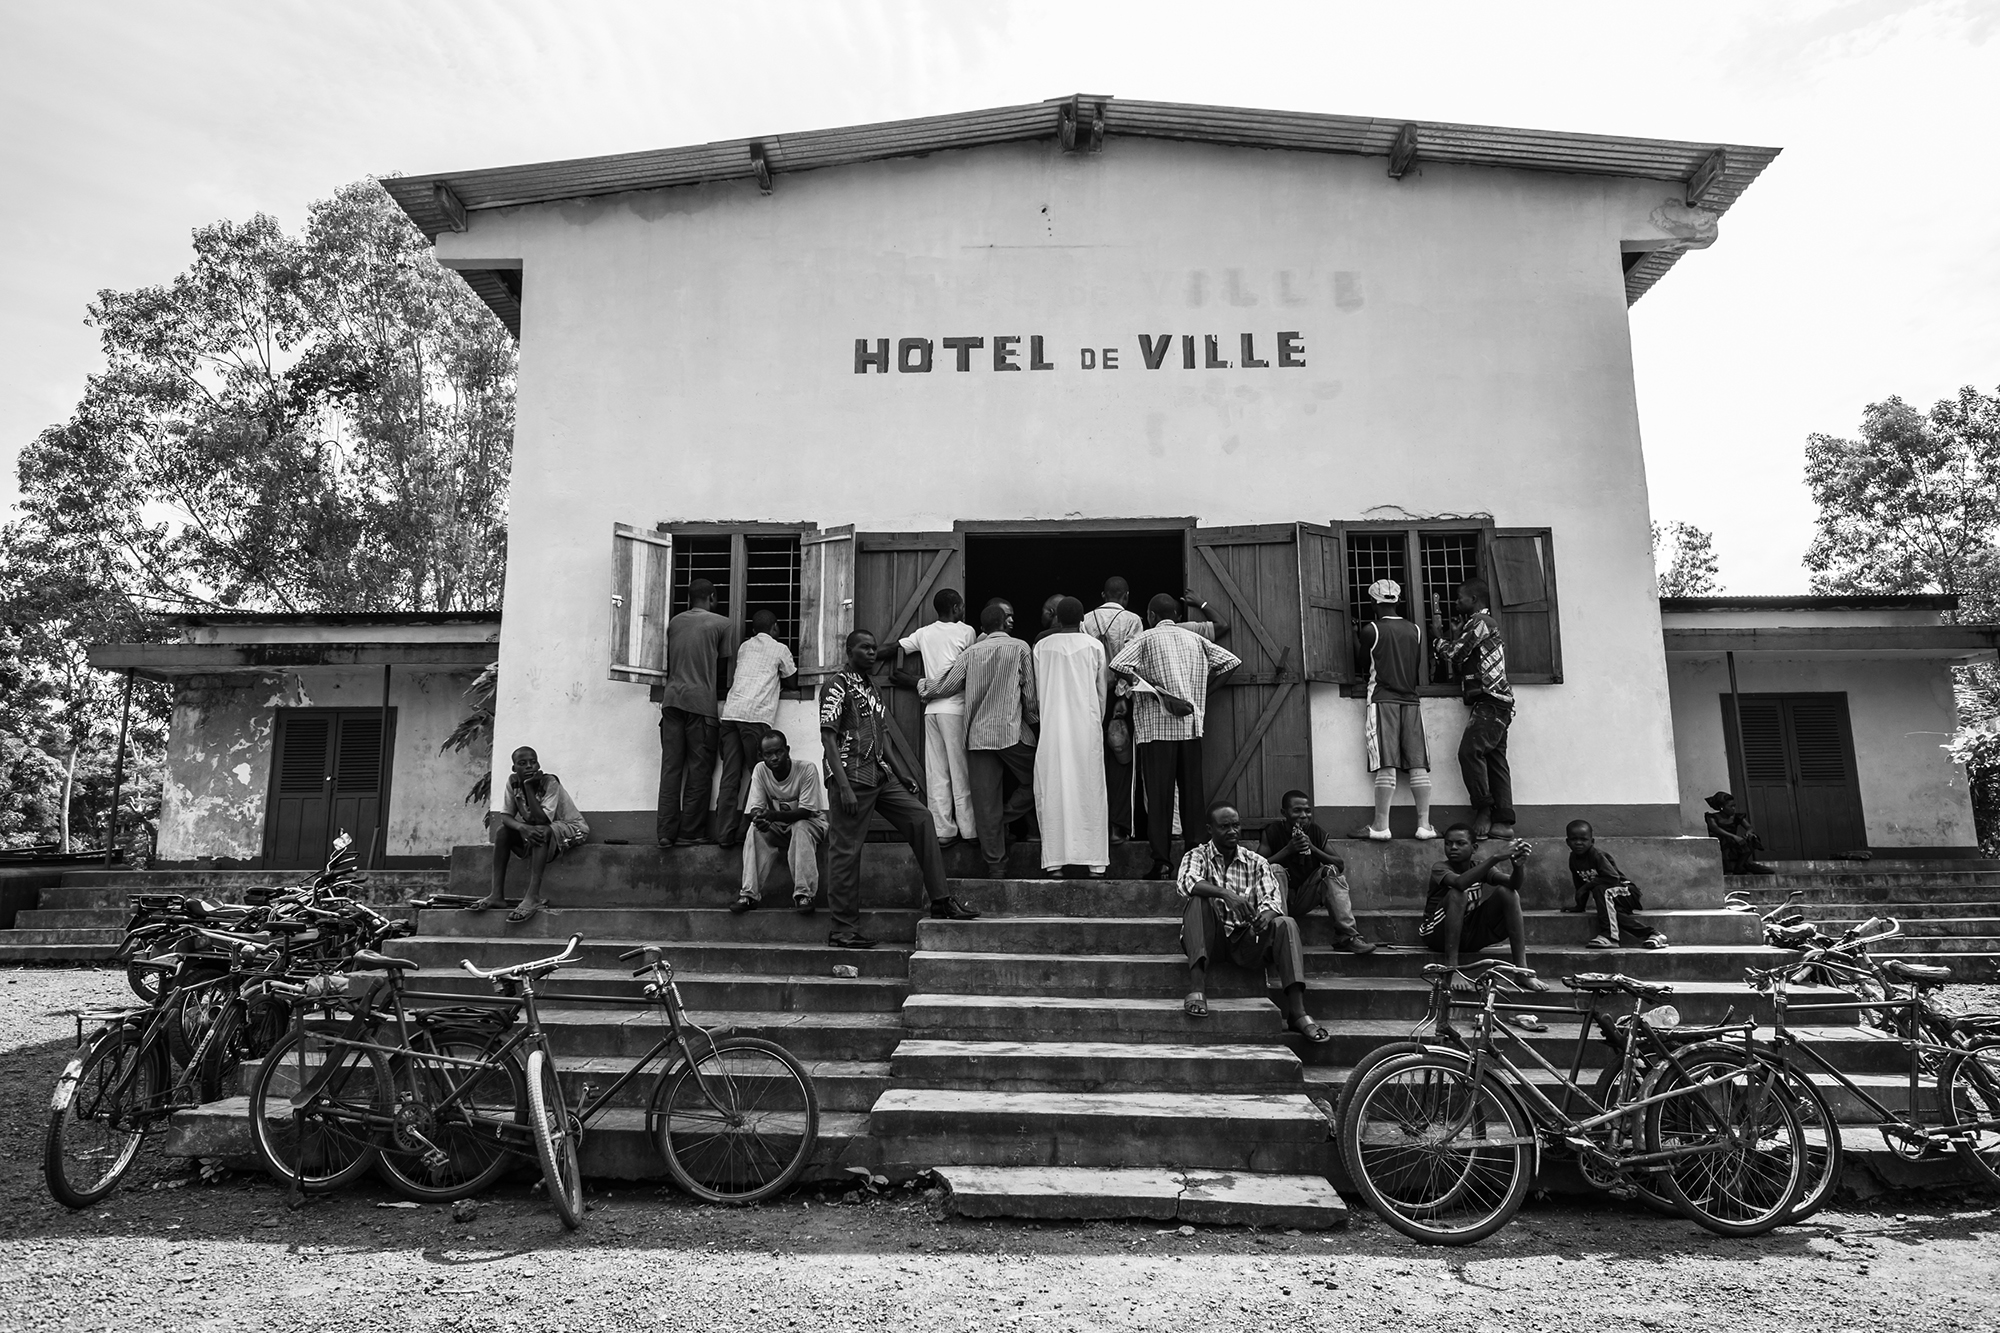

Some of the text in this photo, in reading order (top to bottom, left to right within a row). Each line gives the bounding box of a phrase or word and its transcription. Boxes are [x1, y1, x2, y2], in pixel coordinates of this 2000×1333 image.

[854, 331, 1307, 374] HOTEL DE VILLE
